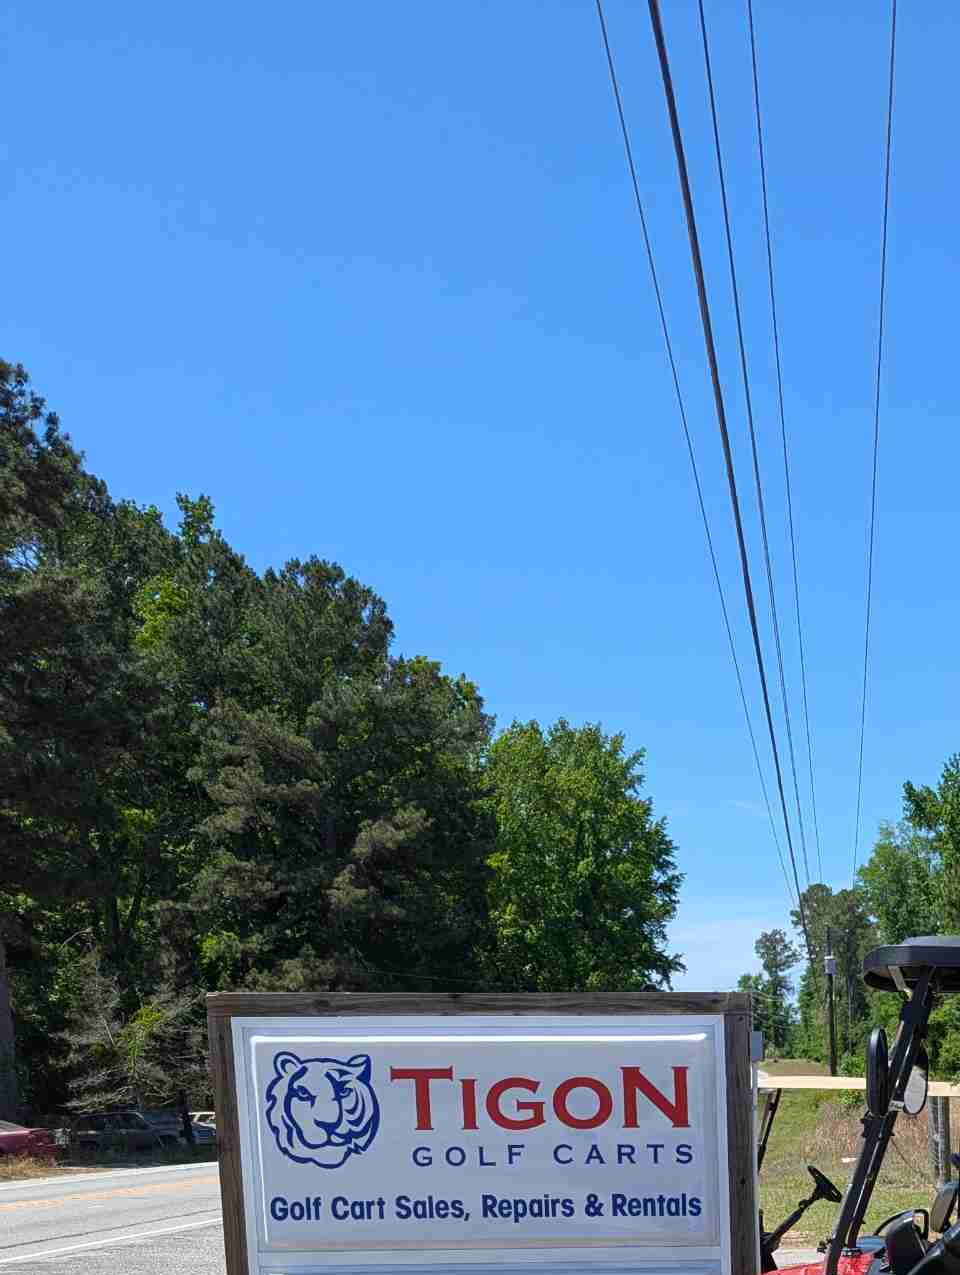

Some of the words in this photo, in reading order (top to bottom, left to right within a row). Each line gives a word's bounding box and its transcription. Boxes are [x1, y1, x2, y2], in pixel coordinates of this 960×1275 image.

[389, 1065, 692, 1131] TIGON
[412, 1143, 526, 1168] GOLF
[552, 1143, 694, 1166] CARTS
[270, 1196, 322, 1222] Golf
[330, 1195, 386, 1221] Cart
[395, 1194, 471, 1222] Sales,
[481, 1193, 576, 1224] Repairs
[584, 1192, 605, 1218] &
[611, 1192, 703, 1218] Rentals
